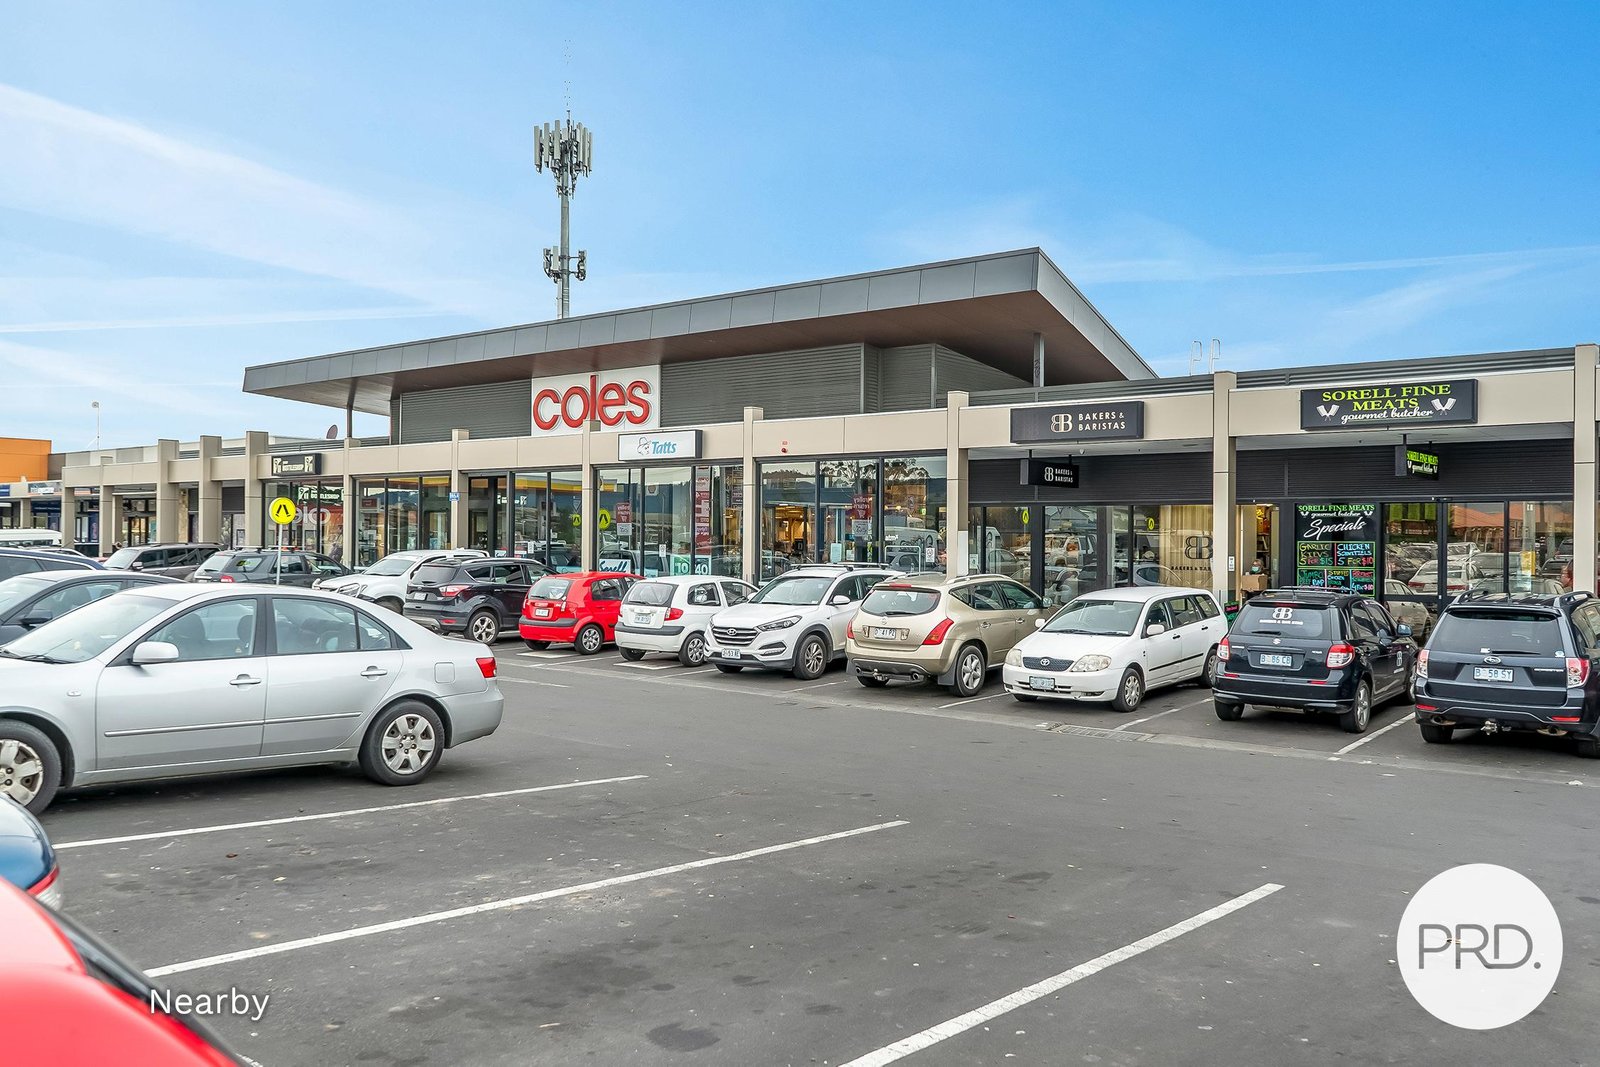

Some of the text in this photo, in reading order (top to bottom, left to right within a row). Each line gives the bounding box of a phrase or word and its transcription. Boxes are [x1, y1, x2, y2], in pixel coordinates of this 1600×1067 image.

[1322, 384, 1451, 402] SORELL FINE
[533, 375, 651, 430] coles
[1352, 398, 1419, 411] MEATS
[1078, 412, 1116, 420] BAKERS
[1341, 406, 1434, 424] gourmet butcher
[1078, 422, 1126, 431] BARISTAS
[652, 442, 676, 454] Tatts
[1055, 468, 1070, 476] BAKERS
[1304, 516, 1366, 540] Specials
[1300, 543, 1332, 552] GARLIC
[1338, 557, 1345, 566] 5
[1262, 654, 1266, 662] B
[1476, 669, 1511, 679] B 58 SY
